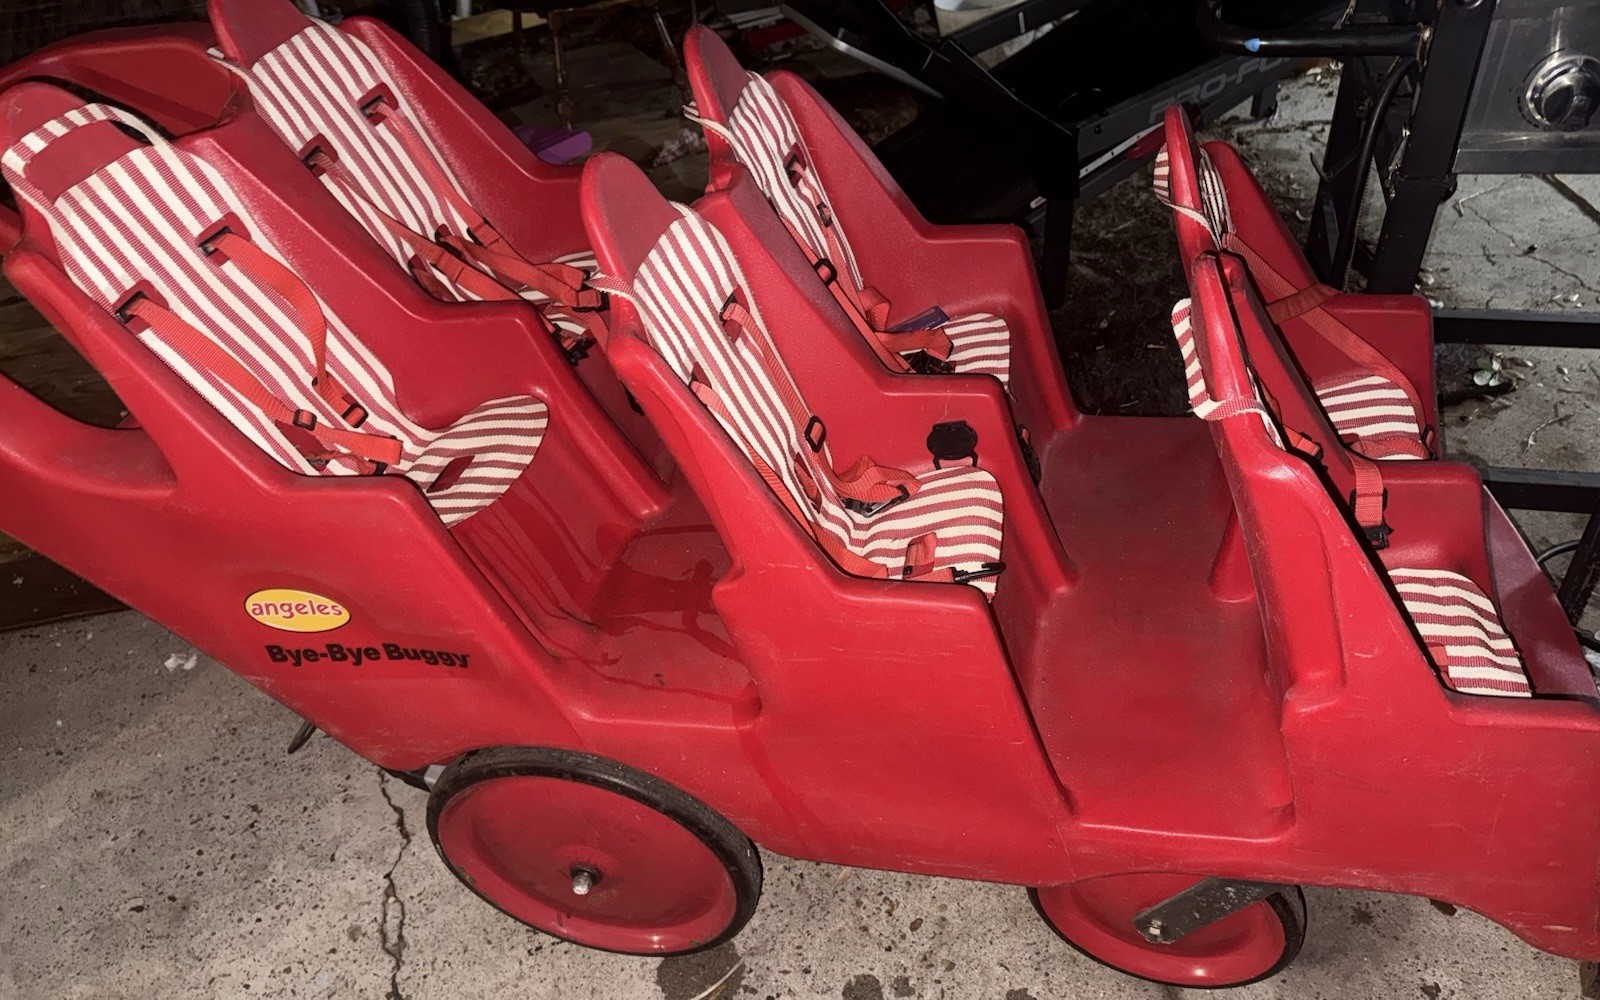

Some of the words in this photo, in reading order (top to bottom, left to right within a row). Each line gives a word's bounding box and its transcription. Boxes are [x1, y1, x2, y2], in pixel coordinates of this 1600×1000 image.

[1148, 56, 1290, 124] PRO-FO
[251, 600, 343, 619] angeles
[265, 643, 381, 667] Bye-Bye
[382, 643, 469, 668] Buggy
